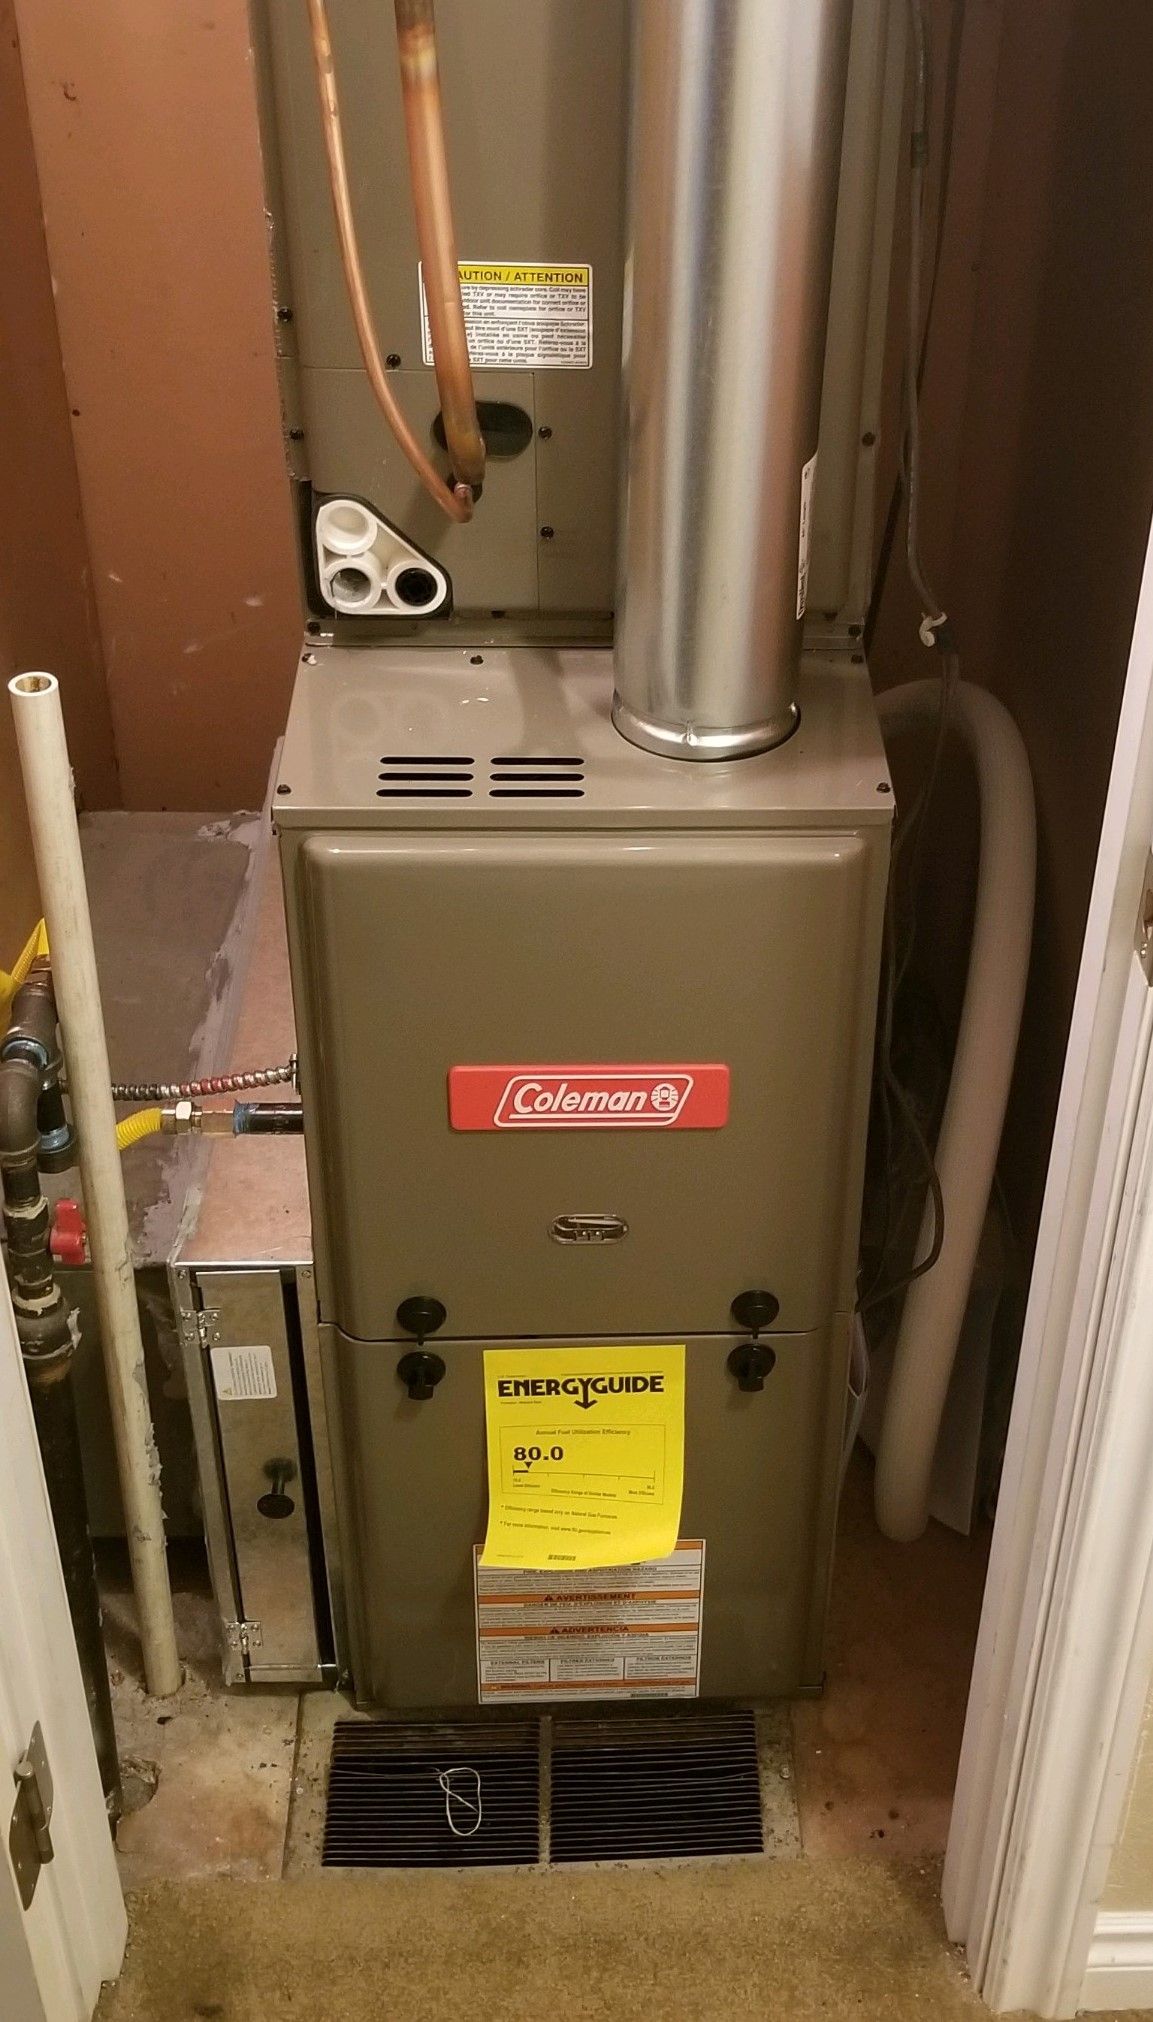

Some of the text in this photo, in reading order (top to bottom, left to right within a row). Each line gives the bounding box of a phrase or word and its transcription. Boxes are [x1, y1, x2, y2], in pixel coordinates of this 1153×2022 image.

[459, 270, 502, 281] AUTION
[514, 271, 583, 283] ATTENTION
[514, 1083, 648, 1114] Coleman
[497, 1376, 664, 1402] ENERGYGUIDE
[513, 1446, 564, 1461] 80.0
[556, 1592, 636, 1602] AVERTISSEMENT
[561, 1626, 629, 1635] ADVERTENCIA
